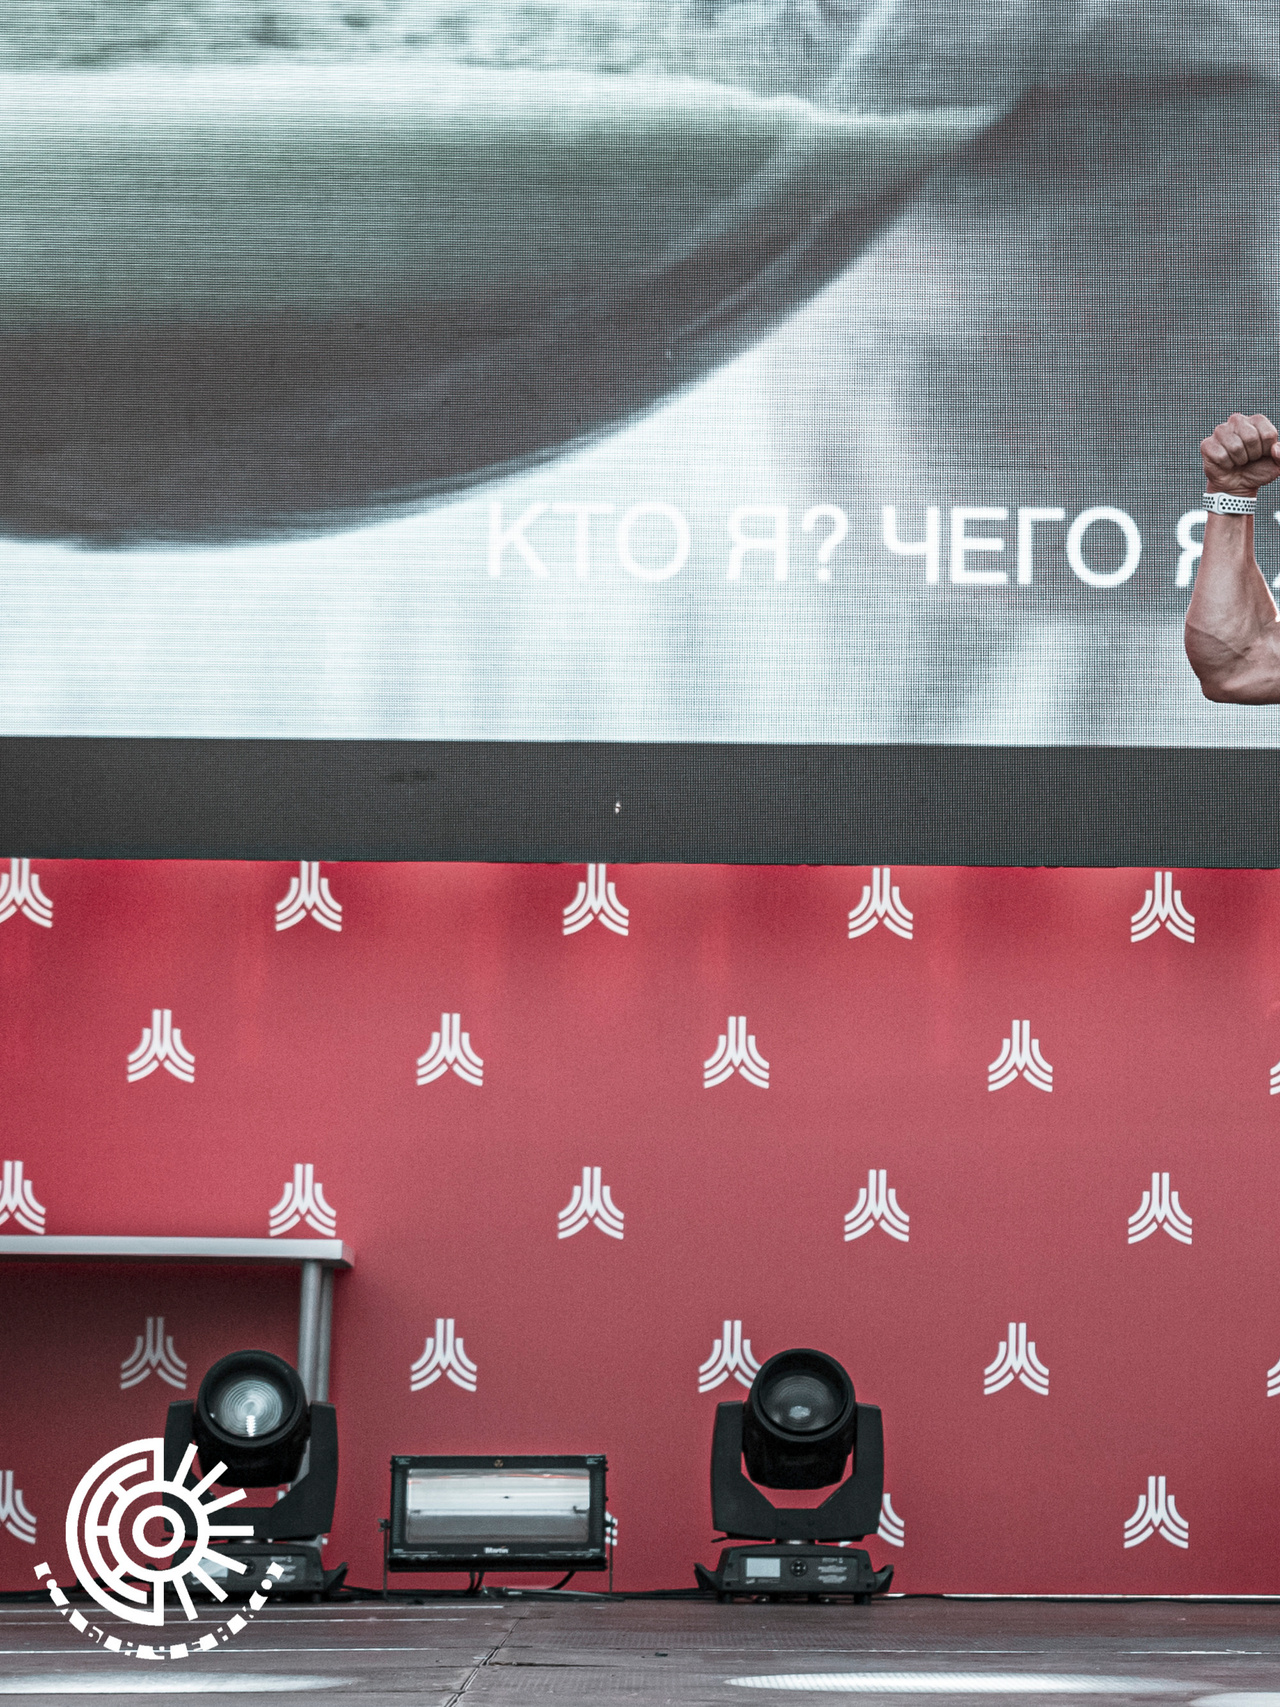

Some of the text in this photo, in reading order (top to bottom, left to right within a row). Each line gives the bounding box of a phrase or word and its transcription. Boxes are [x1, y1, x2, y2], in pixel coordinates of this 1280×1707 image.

[486, 501, 691, 583] КТО
[726, 503, 849, 583] Я?
[881, 504, 1143, 589] ЧЕГО
